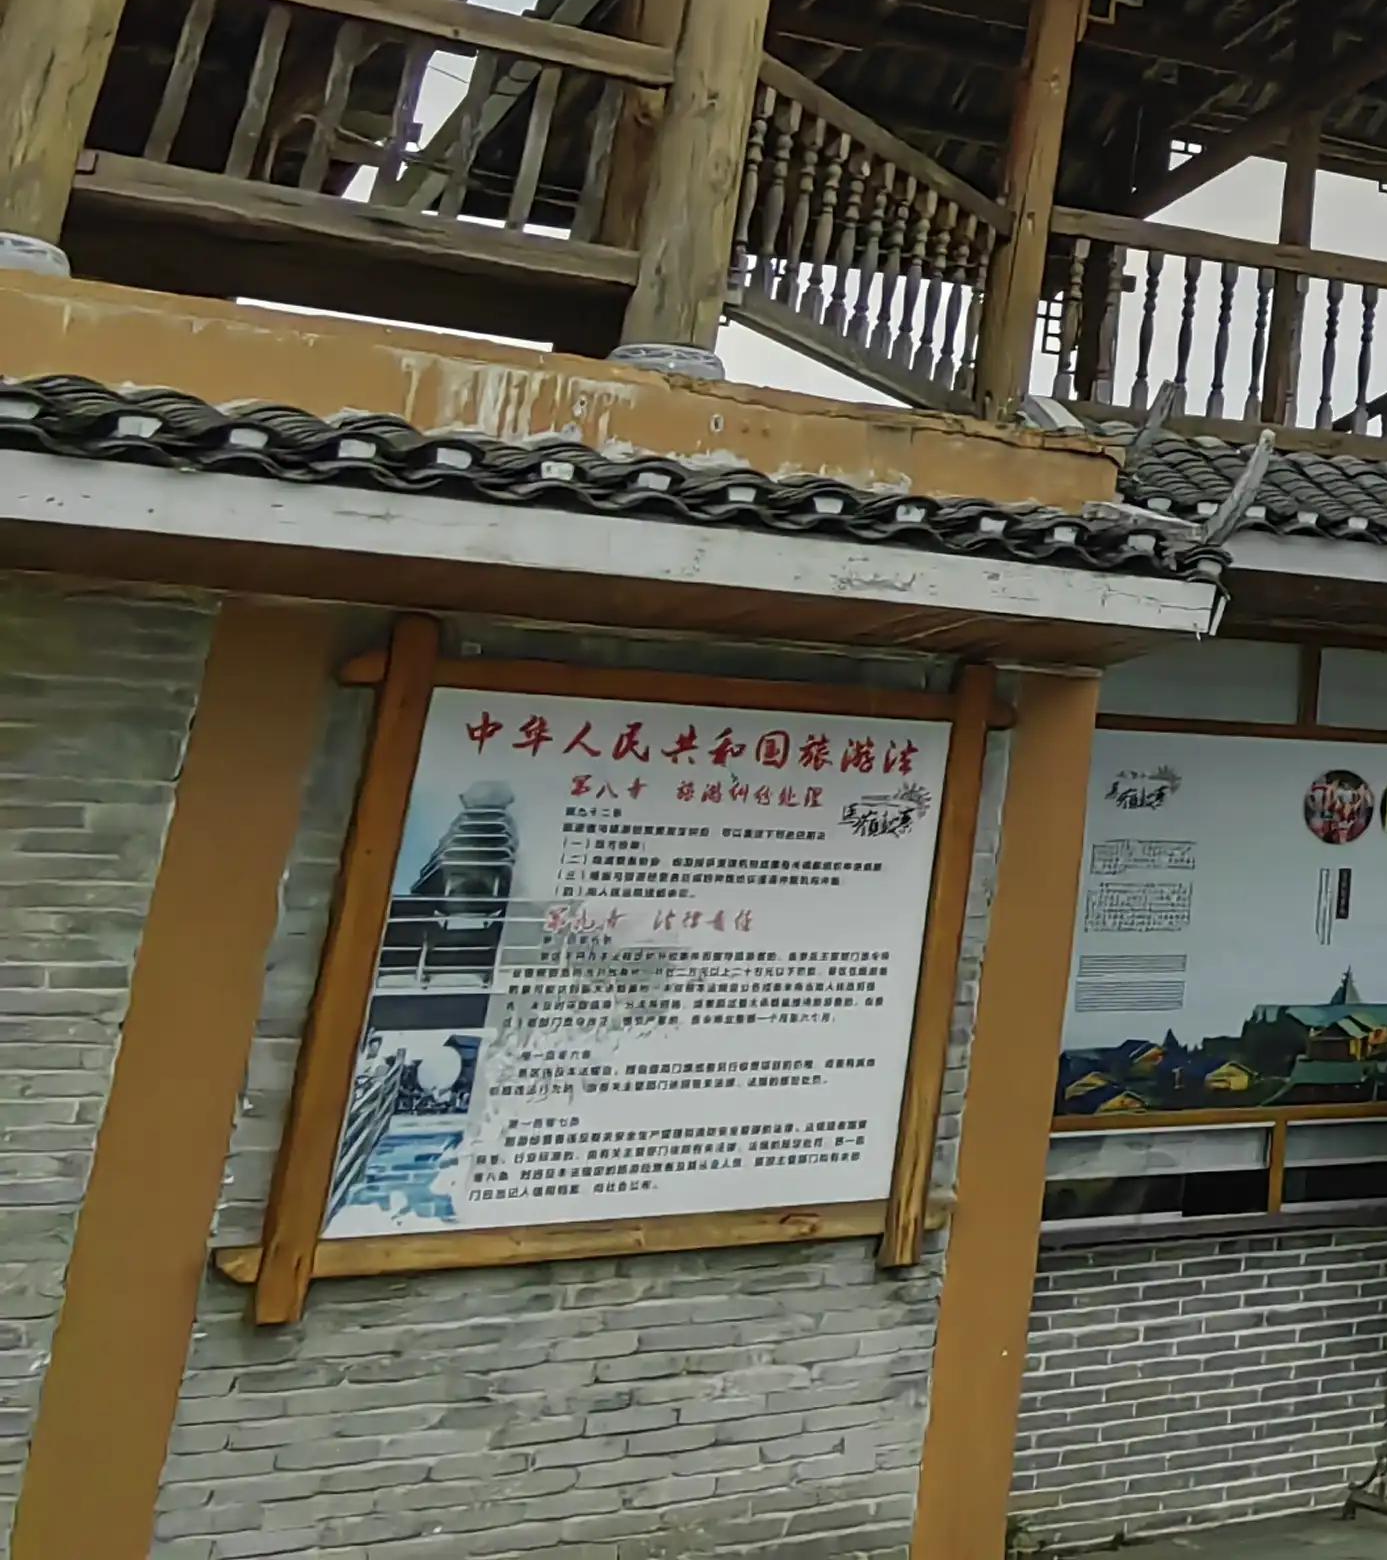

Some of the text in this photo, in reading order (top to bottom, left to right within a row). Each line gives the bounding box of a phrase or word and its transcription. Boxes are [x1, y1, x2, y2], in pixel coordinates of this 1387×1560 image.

[465, 711, 920, 775] 中华人民共和国旅游法
